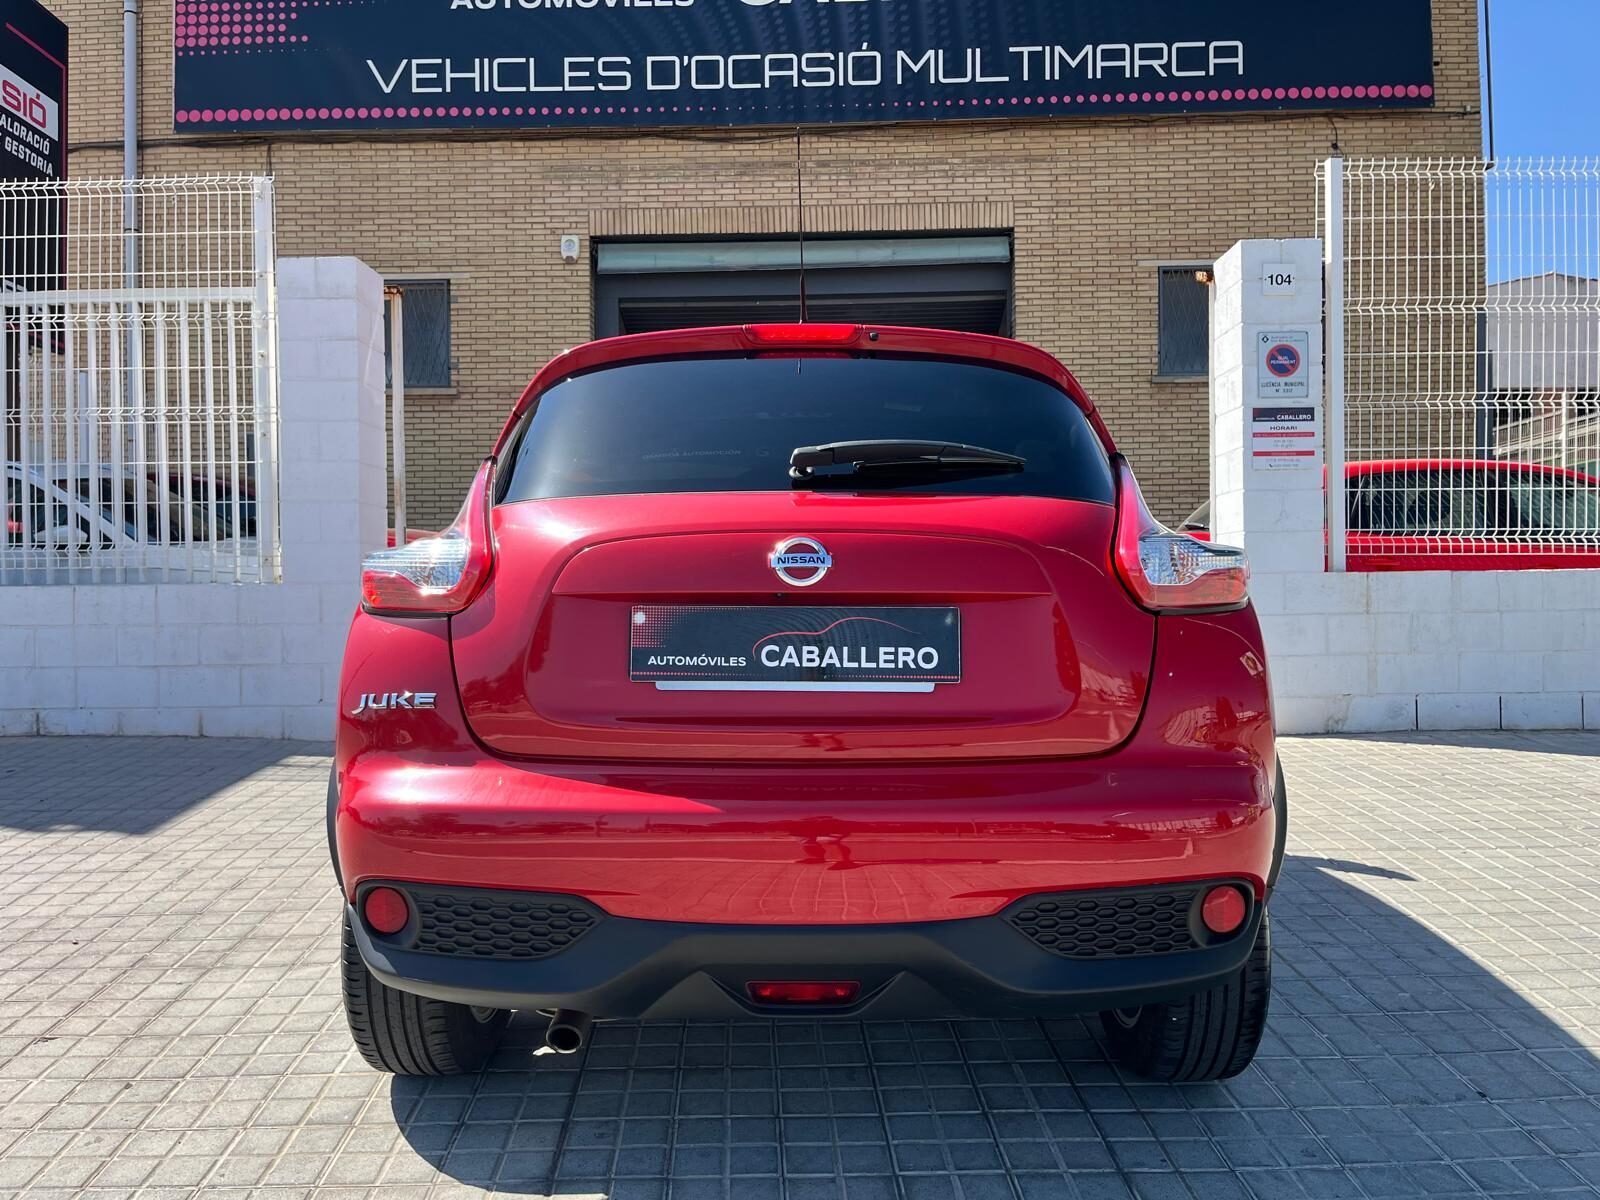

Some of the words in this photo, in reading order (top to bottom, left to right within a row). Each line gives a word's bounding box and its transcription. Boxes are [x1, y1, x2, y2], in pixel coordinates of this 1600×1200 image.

[366, 56, 632, 94] VEHICLES
[646, 42, 882, 91] D'OCASIÓ
[896, 40, 1244, 85] MULTIMARCA
[0, 112, 50, 155] ALORACIÓ
[4, 136, 53, 177] GESTORIA
[1267, 273, 1292, 286] 104
[777, 556, 826, 565] NISSAN
[648, 653, 747, 667] AUTOMÓVILES
[760, 644, 939, 669] CABALLERO
[351, 690, 437, 715] JUKE
